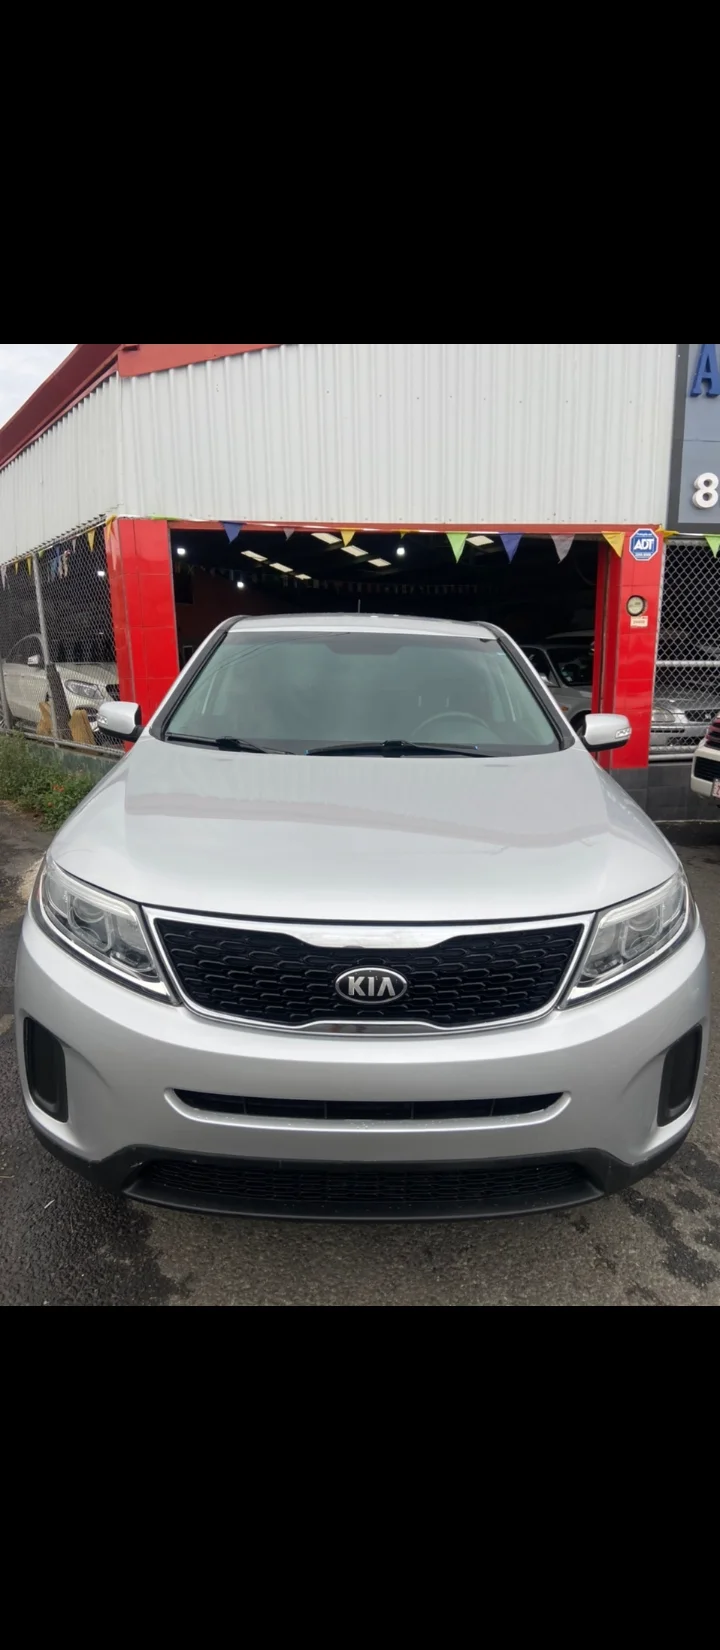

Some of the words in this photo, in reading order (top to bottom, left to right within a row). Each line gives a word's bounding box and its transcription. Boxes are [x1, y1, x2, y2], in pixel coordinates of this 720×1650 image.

[692, 472, 719, 509] 8
[633, 538, 655, 550] ADT
[347, 975, 396, 997] KIA
